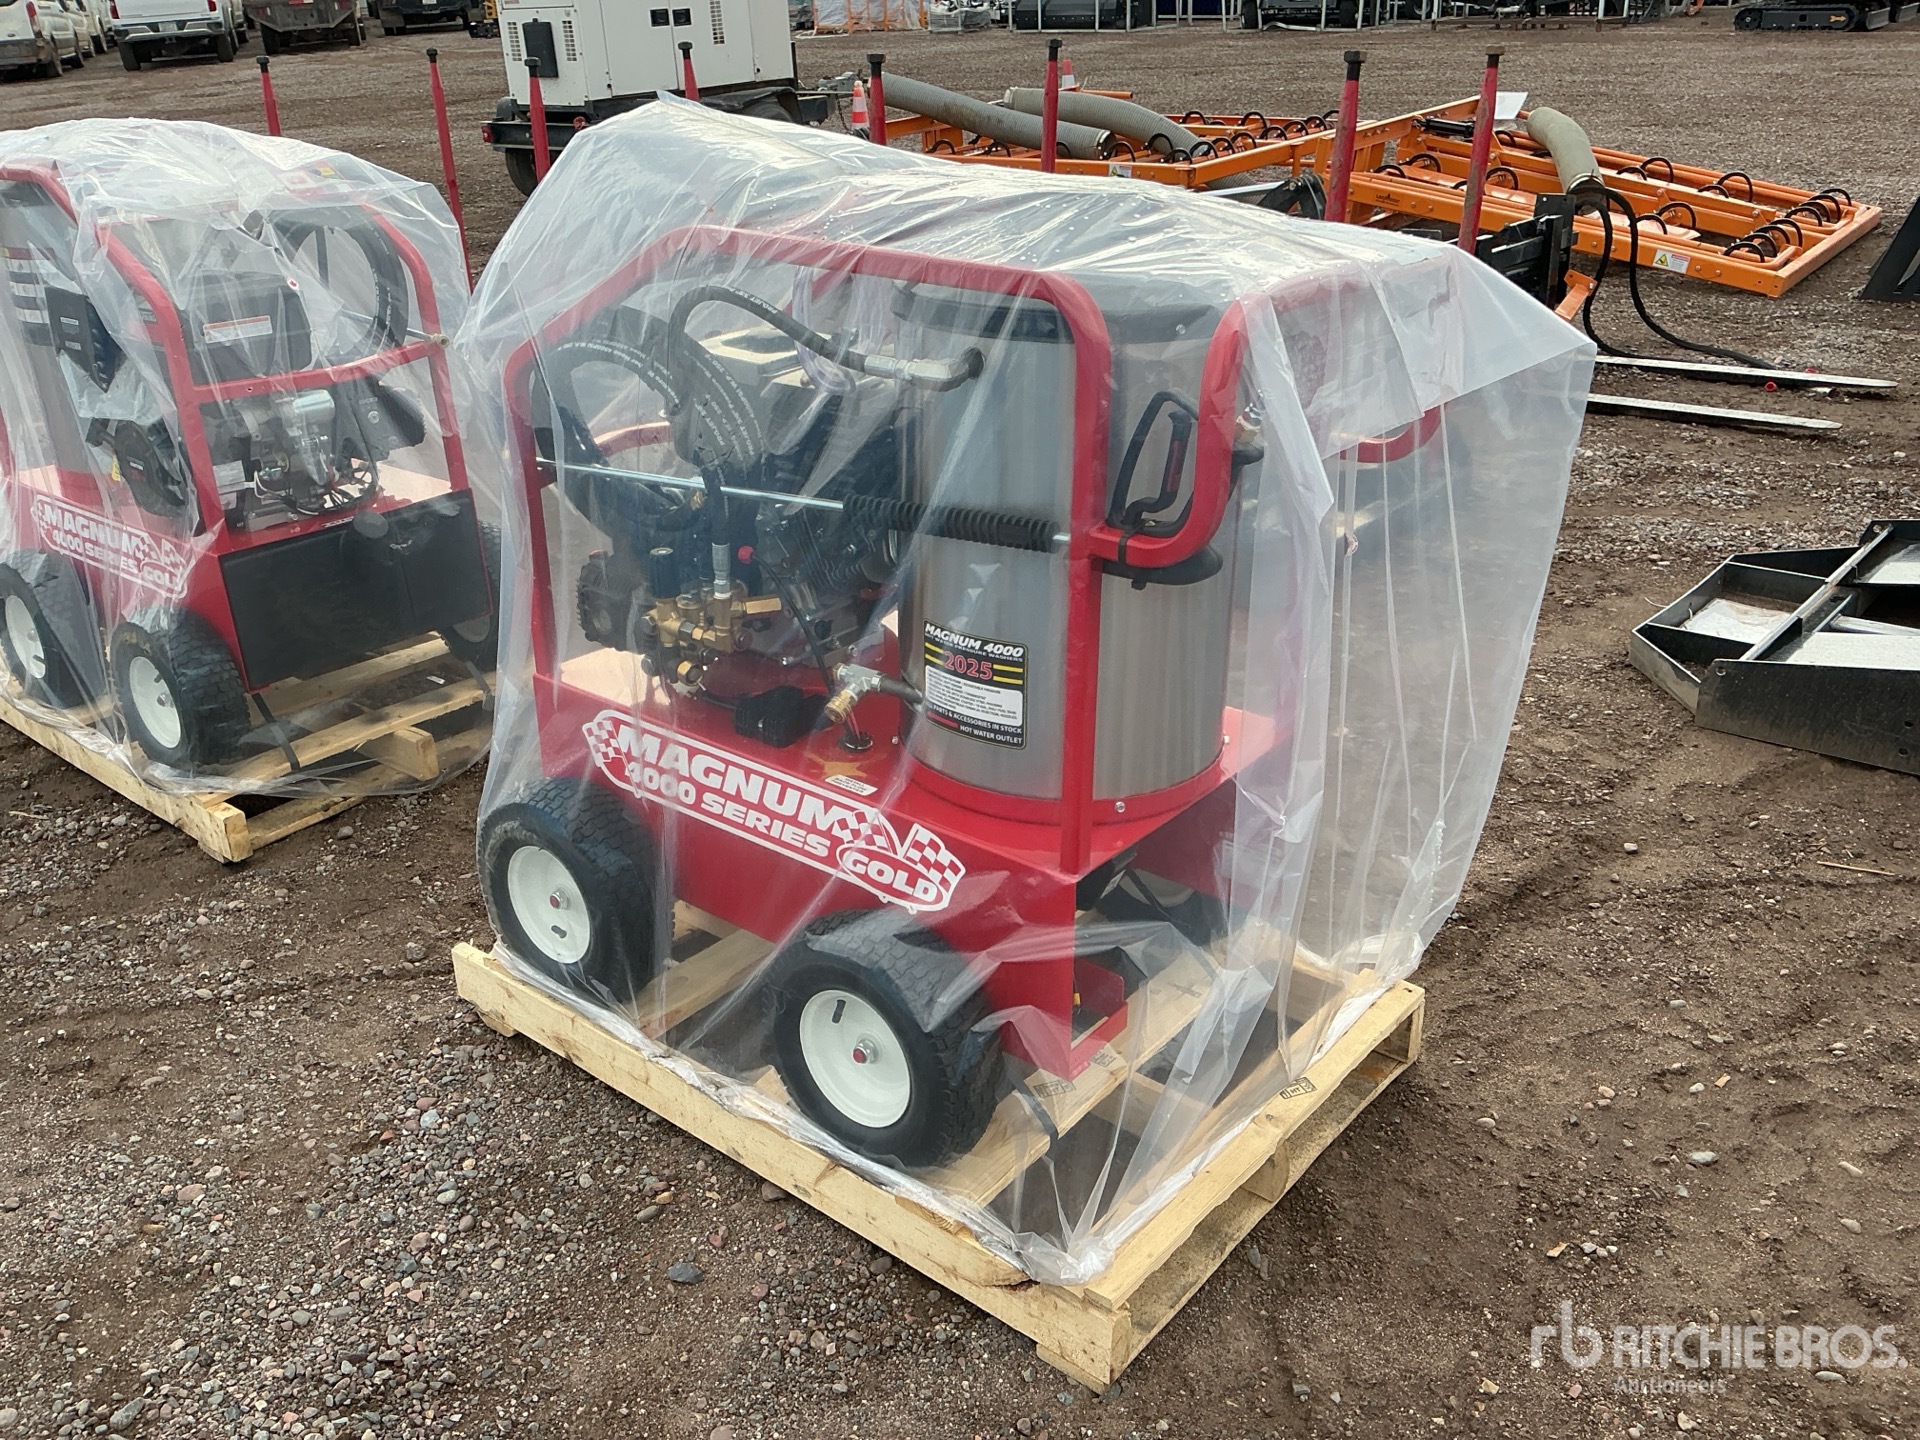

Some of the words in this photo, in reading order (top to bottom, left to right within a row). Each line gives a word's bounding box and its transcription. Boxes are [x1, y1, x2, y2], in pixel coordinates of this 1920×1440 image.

[44, 504, 140, 555] MAGNUM
[925, 623, 982, 650] MAGNUM
[983, 643, 1024, 657] 4000
[943, 650, 993, 680] 2025
[988, 653, 1023, 662] WASHERS
[933, 705, 948, 715] PARTS
[953, 713, 991, 729] ACCESSORIES
[1000, 725, 1022, 734] STOCK
[960, 725, 972, 733] HOT
[972, 728, 994, 739] WATER
[995, 735, 1023, 744] OUTLET
[616, 724, 844, 832] MAGNUM
[624, 761, 696, 804] 4000
[700, 794, 831, 858] SERIES
[845, 854, 939, 902] GOLD
